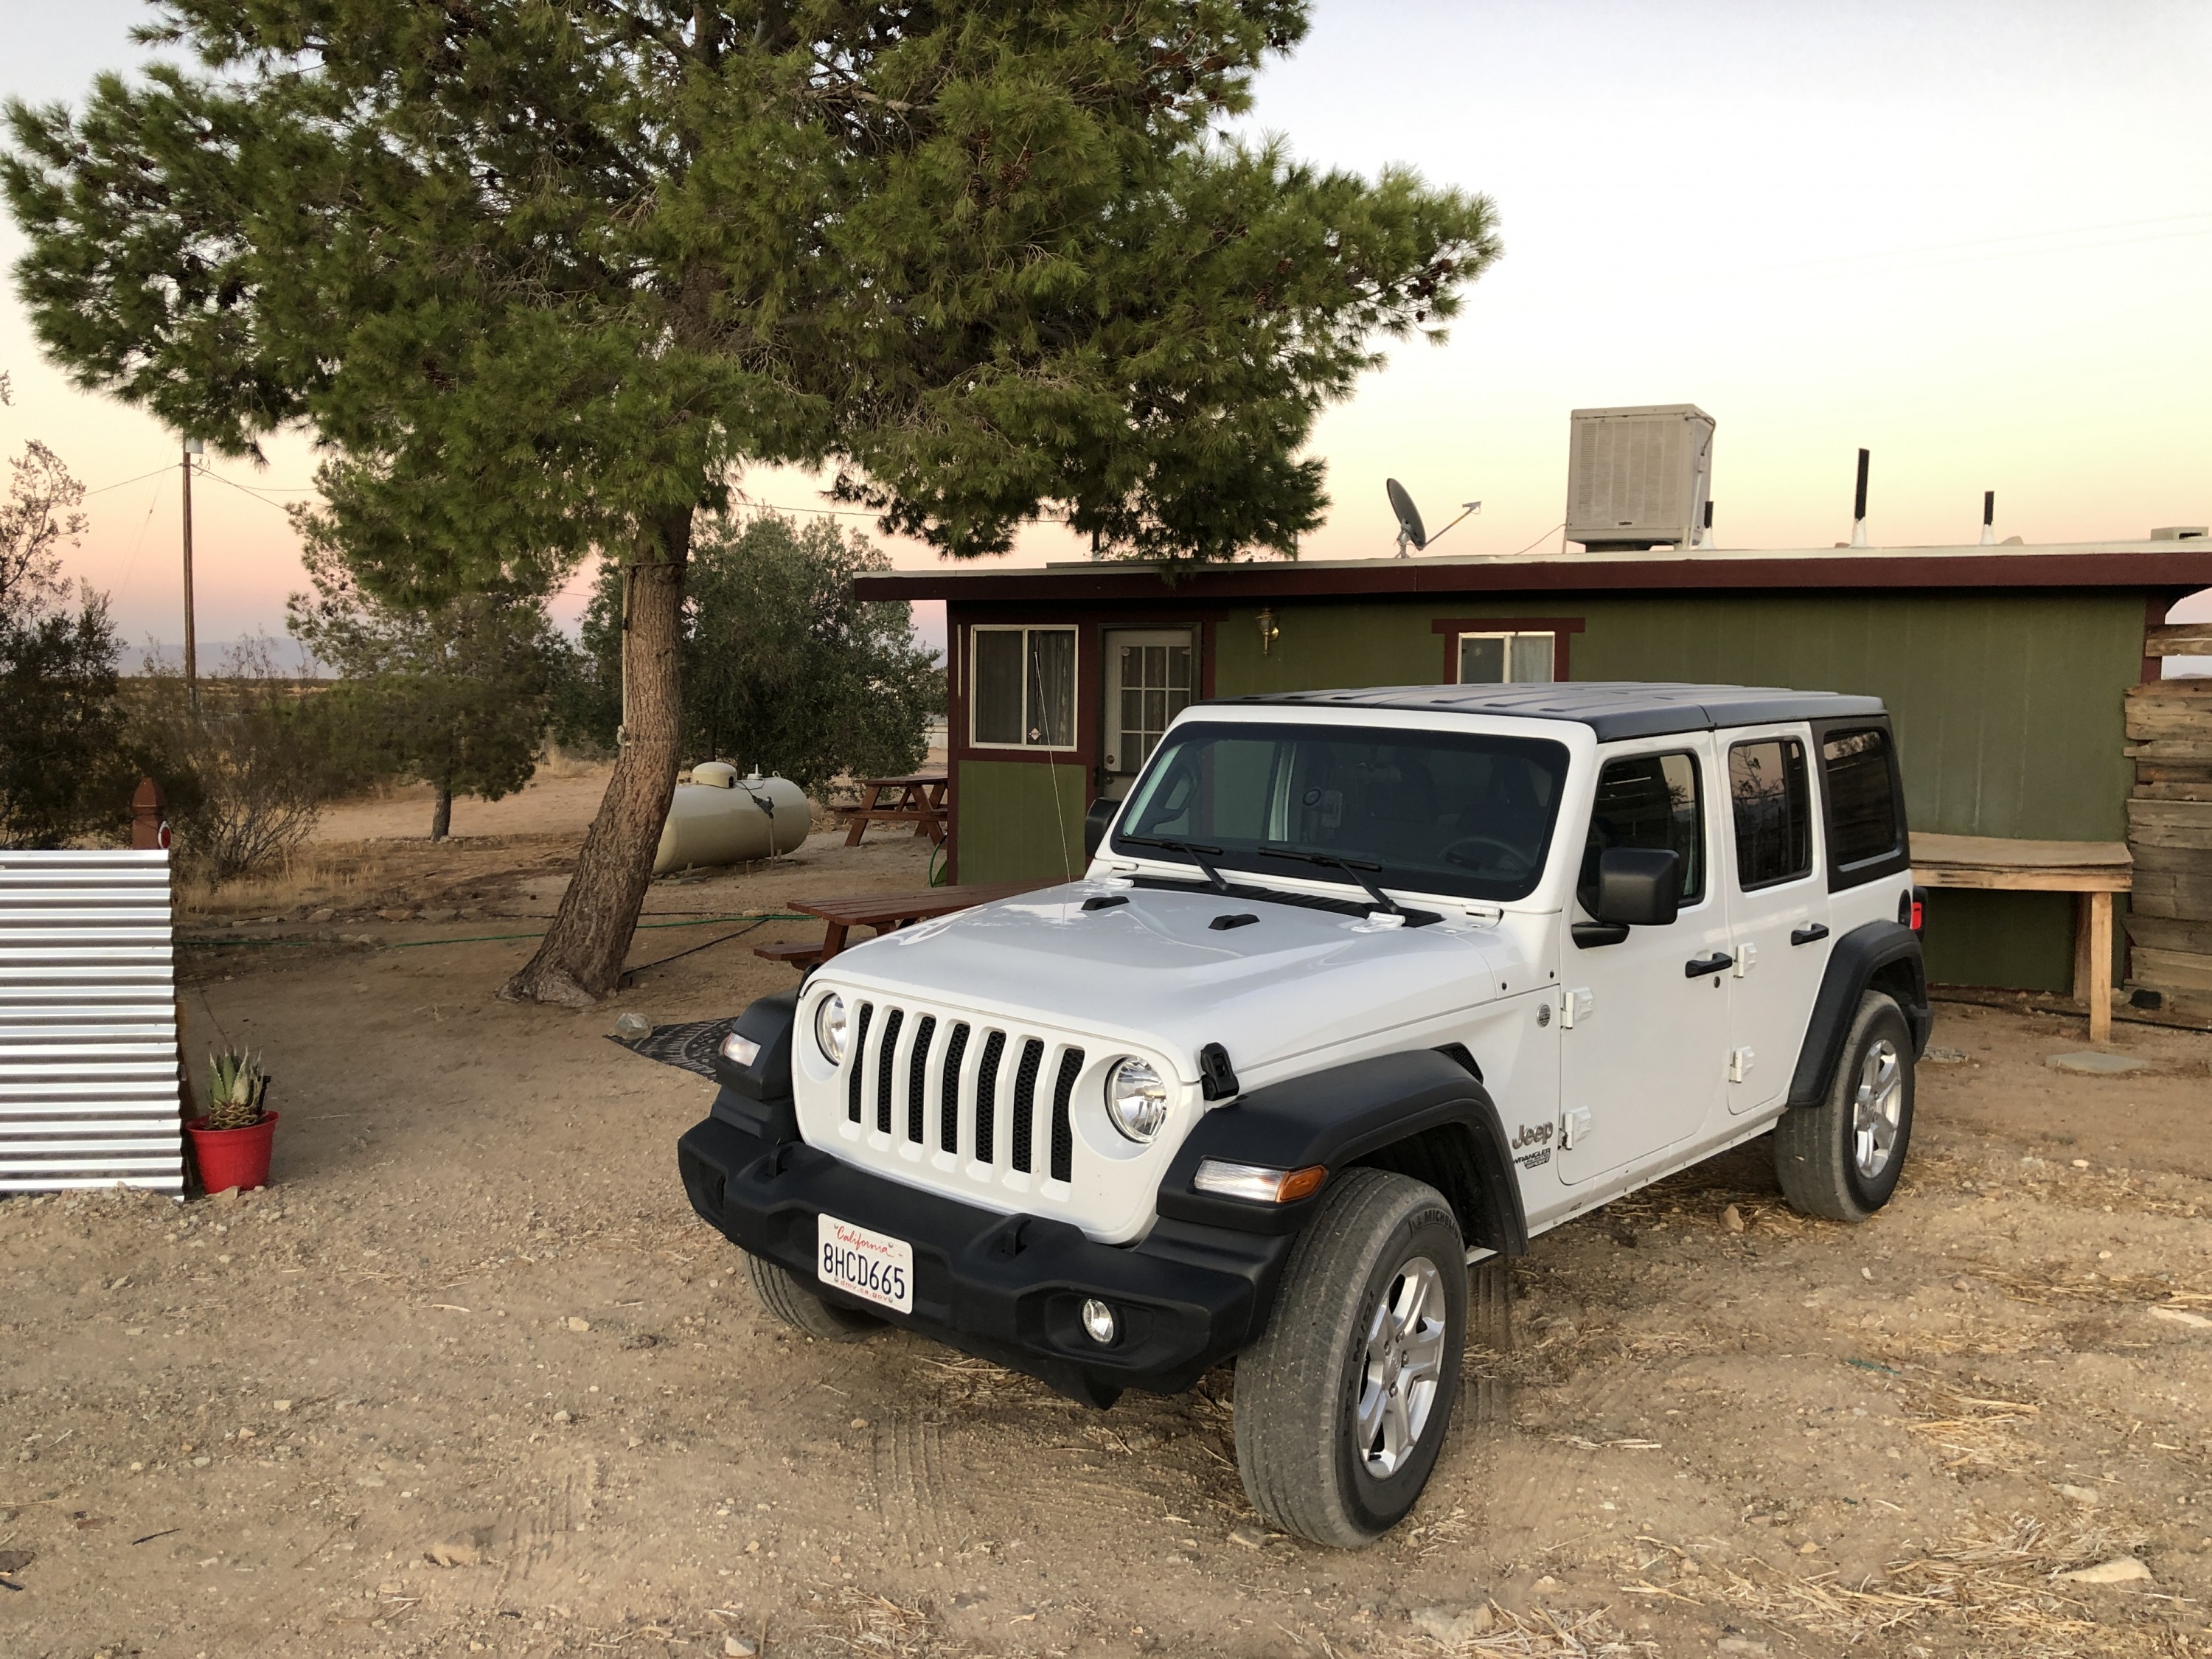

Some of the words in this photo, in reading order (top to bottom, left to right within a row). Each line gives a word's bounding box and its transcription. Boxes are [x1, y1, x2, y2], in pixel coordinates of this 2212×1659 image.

[1512, 1121, 1553, 1150] Jeep
[1513, 1147, 1551, 1164] WRANGLER
[1424, 1209, 1458, 1239] MICHELIN
[837, 1225, 894, 1258] California
[824, 1242, 905, 1299] 8HCD665
[841, 1279, 889, 1301] dmv.ca.gov
